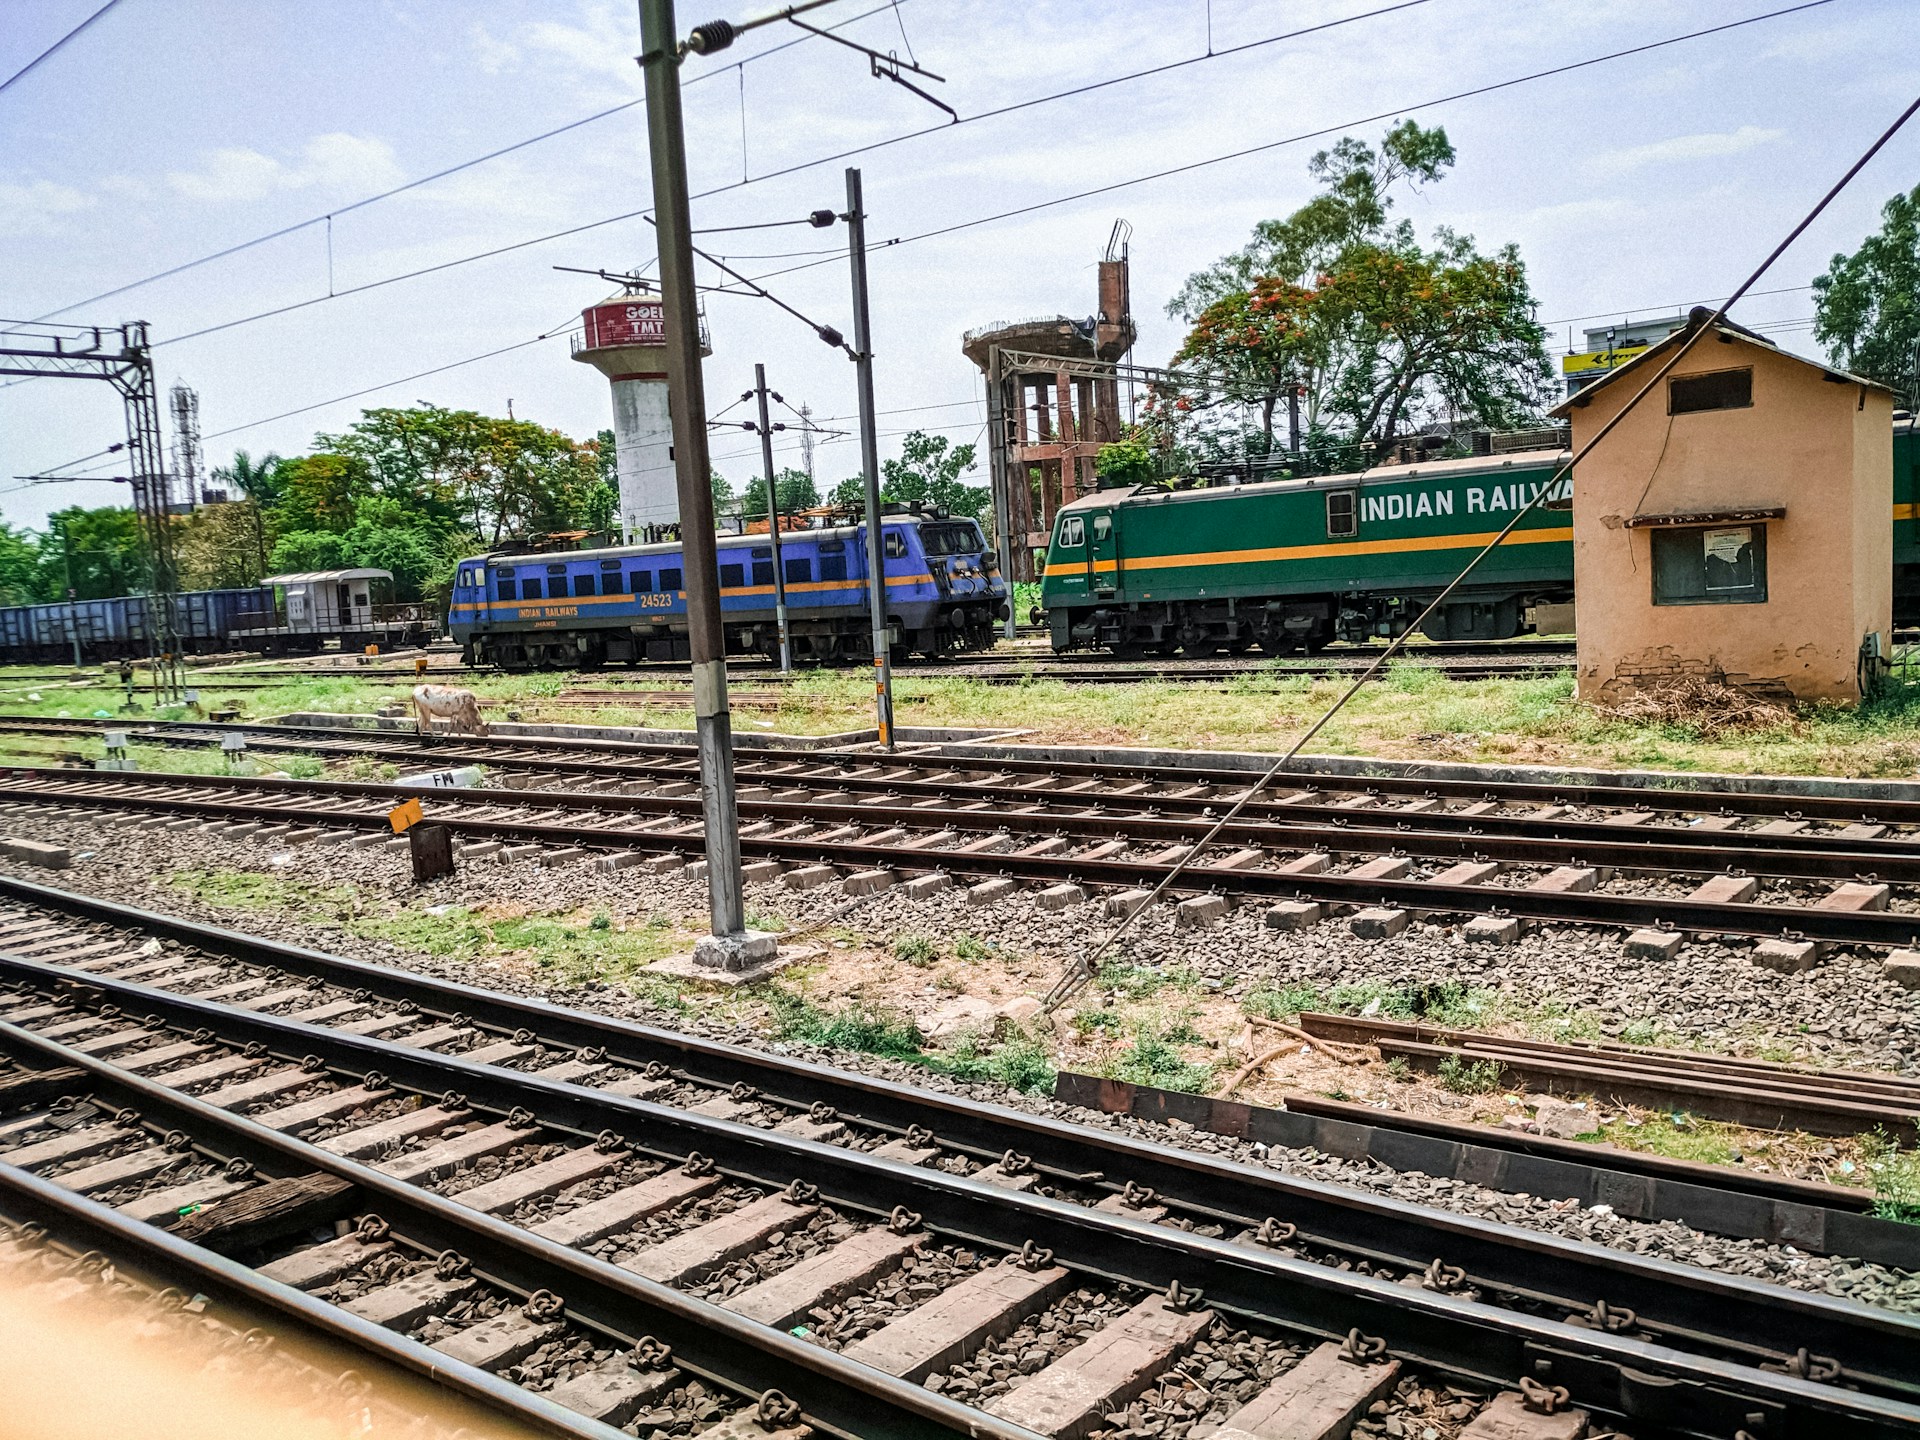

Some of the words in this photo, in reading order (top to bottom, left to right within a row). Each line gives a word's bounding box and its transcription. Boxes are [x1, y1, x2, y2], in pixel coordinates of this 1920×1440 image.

[632, 322, 663, 333] TMT
[1361, 490, 1453, 522] INDIAN
[641, 594, 672, 608] 24523
[518, 609, 541, 619] INDIAN
[545, 607, 578, 617] RAILWAYS
[433, 773, 454, 787] FM
